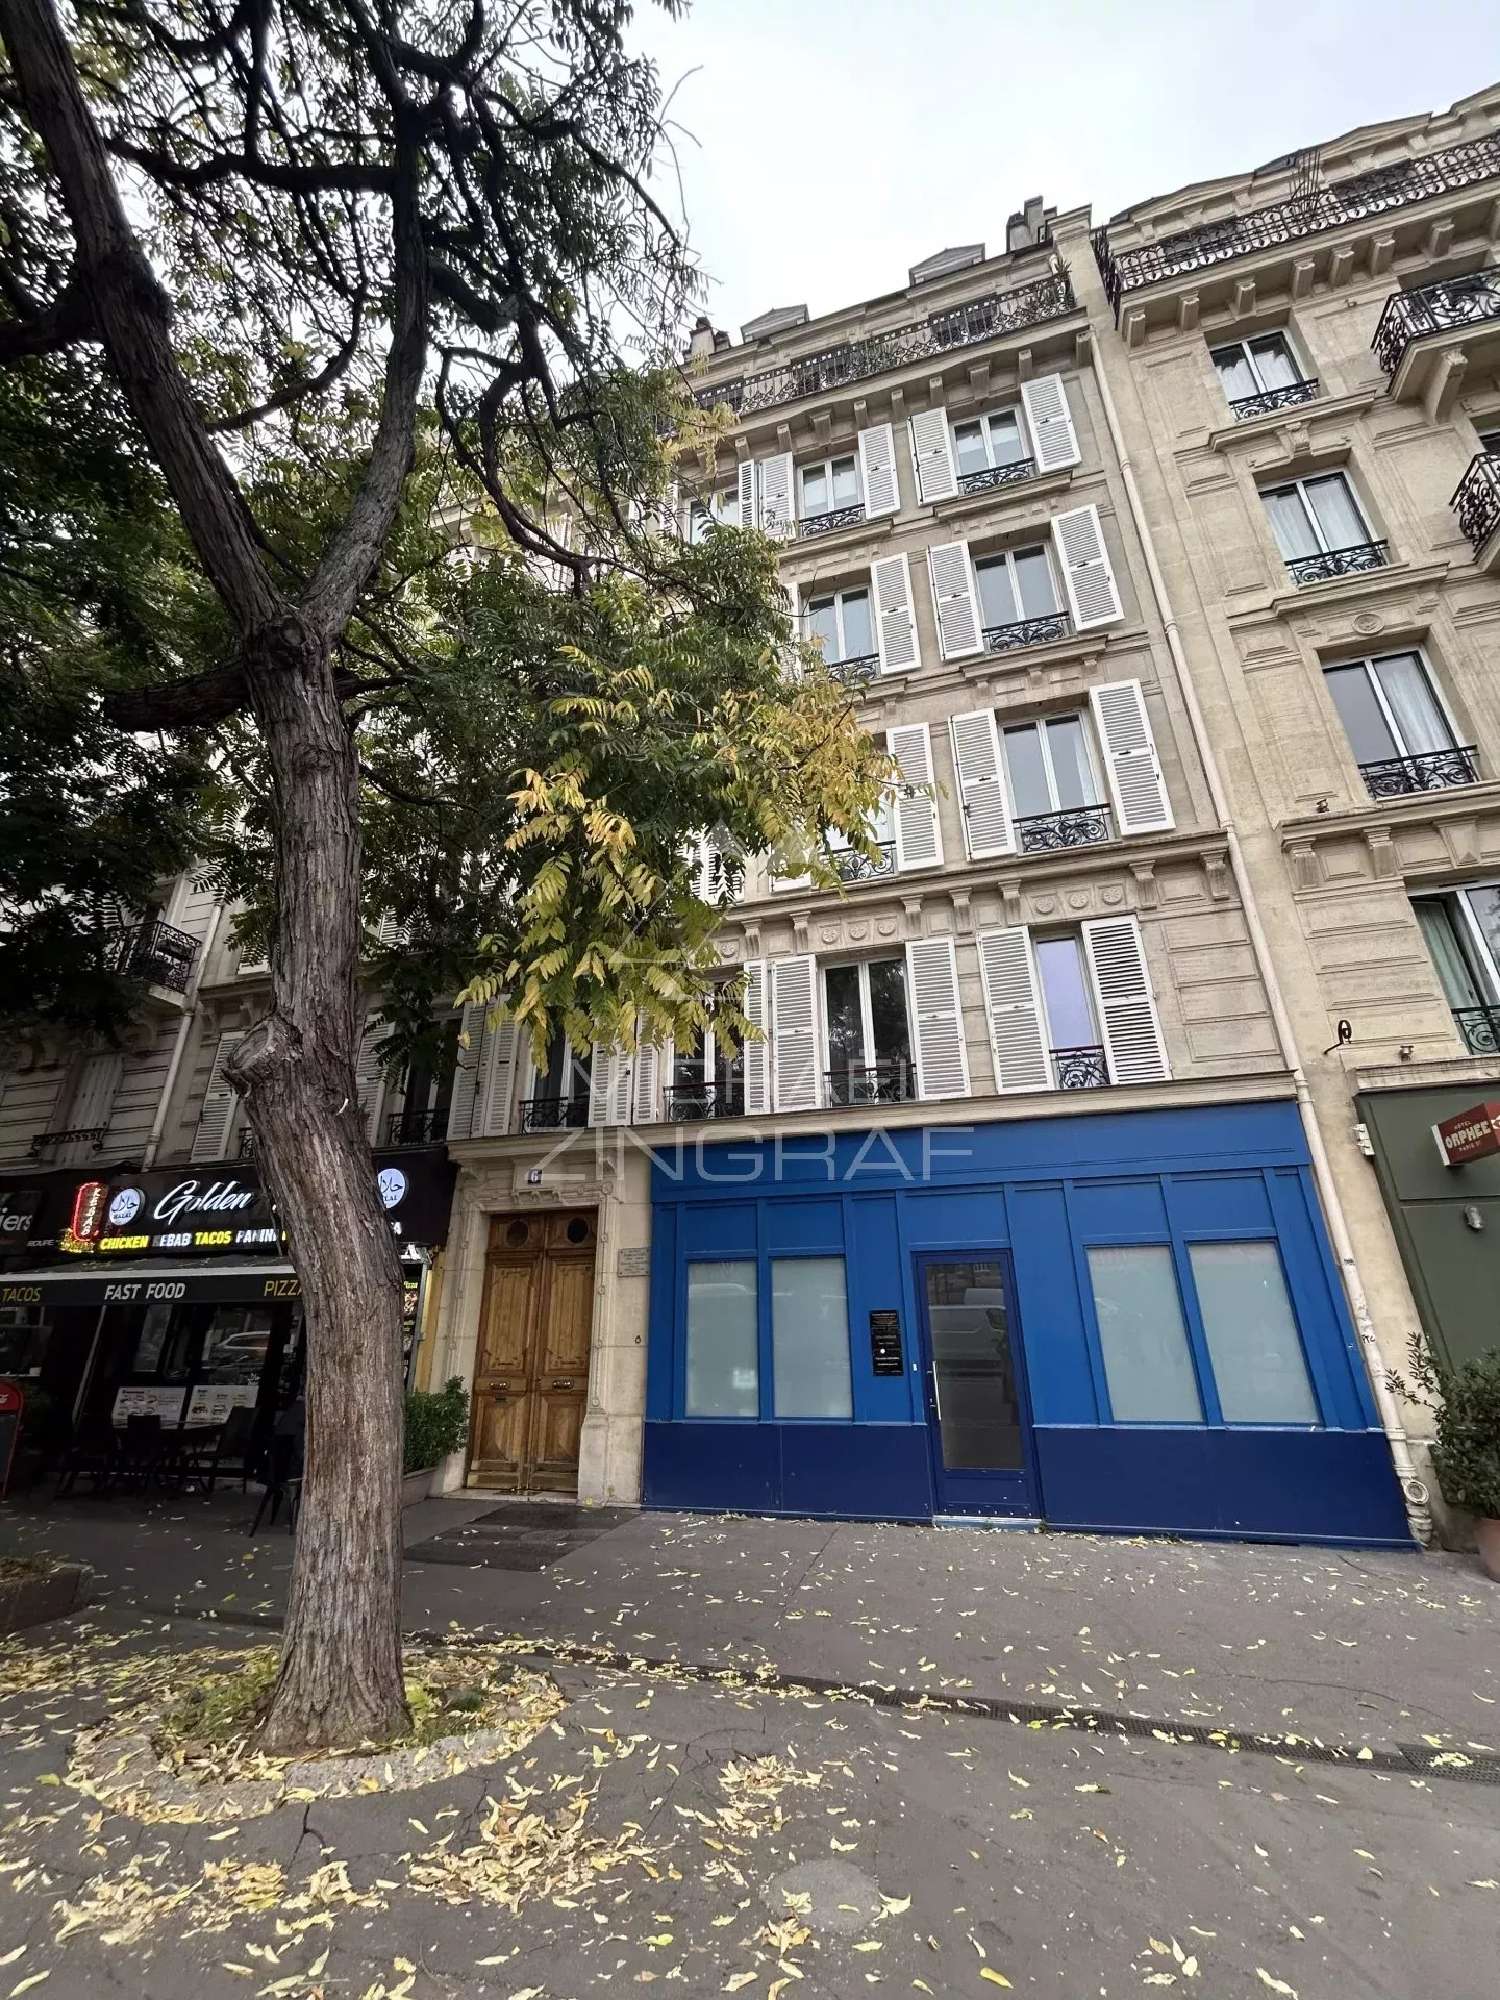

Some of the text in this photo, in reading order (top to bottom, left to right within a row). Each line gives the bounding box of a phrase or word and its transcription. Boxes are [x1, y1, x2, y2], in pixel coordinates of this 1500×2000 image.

[153, 1180, 253, 1225] Golden
[100, 1235, 149, 1250] CHICKEN
[152, 1232, 193, 1248] KEBAB
[195, 1230, 233, 1245] TACOS
[2, 1287, 42, 1302] TACOS
[104, 1284, 142, 1300] FAST
[146, 1282, 186, 1299] FOOD
